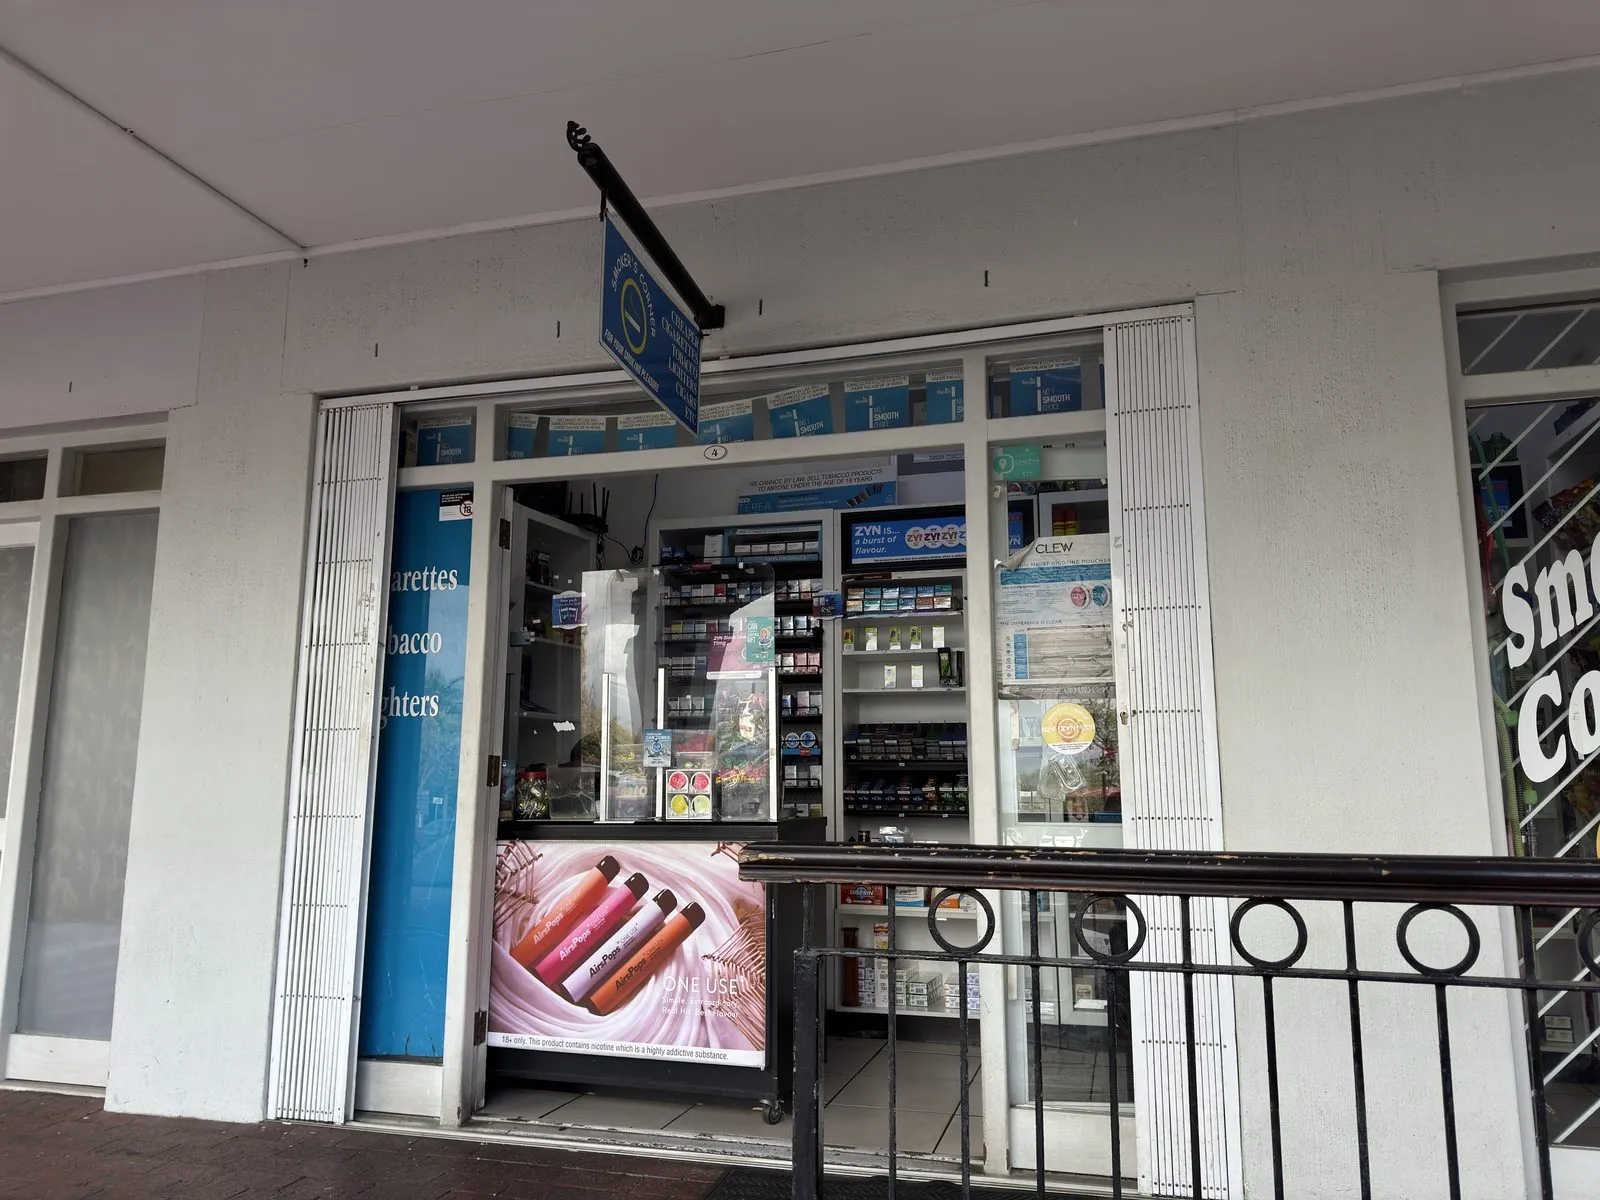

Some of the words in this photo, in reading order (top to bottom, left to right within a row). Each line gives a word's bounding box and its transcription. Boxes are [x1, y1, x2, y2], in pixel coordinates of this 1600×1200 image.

[639, 273, 656, 337] CORNER
[661, 316, 699, 364] CIGARETTES
[671, 310, 699, 349] CHEAPER
[671, 343, 698, 379] TOBACCO
[668, 356, 697, 395] LIGHTERS
[675, 381, 697, 410] CIGARS
[1042, 393, 1071, 404] SMOOTH
[685, 406, 697, 425] ETC
[800, 420, 824, 434] SMOOTH
[873, 411, 900, 422] SMOOTH
[807, 474, 821, 482] SELL
[822, 471, 850, 480] TOBACCO
[850, 468, 883, 478] PRODUCTS
[853, 476, 873, 484] YEARS
[855, 525, 882, 537] ZYN
[862, 537, 885, 545] burst
[887, 535, 897, 543] of
[855, 546, 887, 554] flavour.
[1035, 542, 1074, 554] CLEW
[391, 565, 458, 592] arettes
[387, 624, 443, 655] bacco
[380, 686, 440, 730] ghters
[533, 912, 564, 945] AirsPops
[559, 929, 592, 961] AirsPops
[589, 945, 621, 979] AirsPops
[615, 957, 647, 990] AirsPops
[663, 976, 700, 993] ONE
[662, 1007, 678, 1015] Real
[502, 1035, 513, 1044] 18+
[514, 1036, 528, 1046] only.
[529, 1037, 541, 1045] This
[541, 1038, 564, 1049] product
[565, 1040, 590, 1050] contains
[590, 1042, 614, 1052] nicotine
[615, 1043, 633, 1053] which
[646, 1045, 665, 1057] highly
[666, 1047, 694, 1058] addictive
[694, 1049, 729, 1060] substance.
